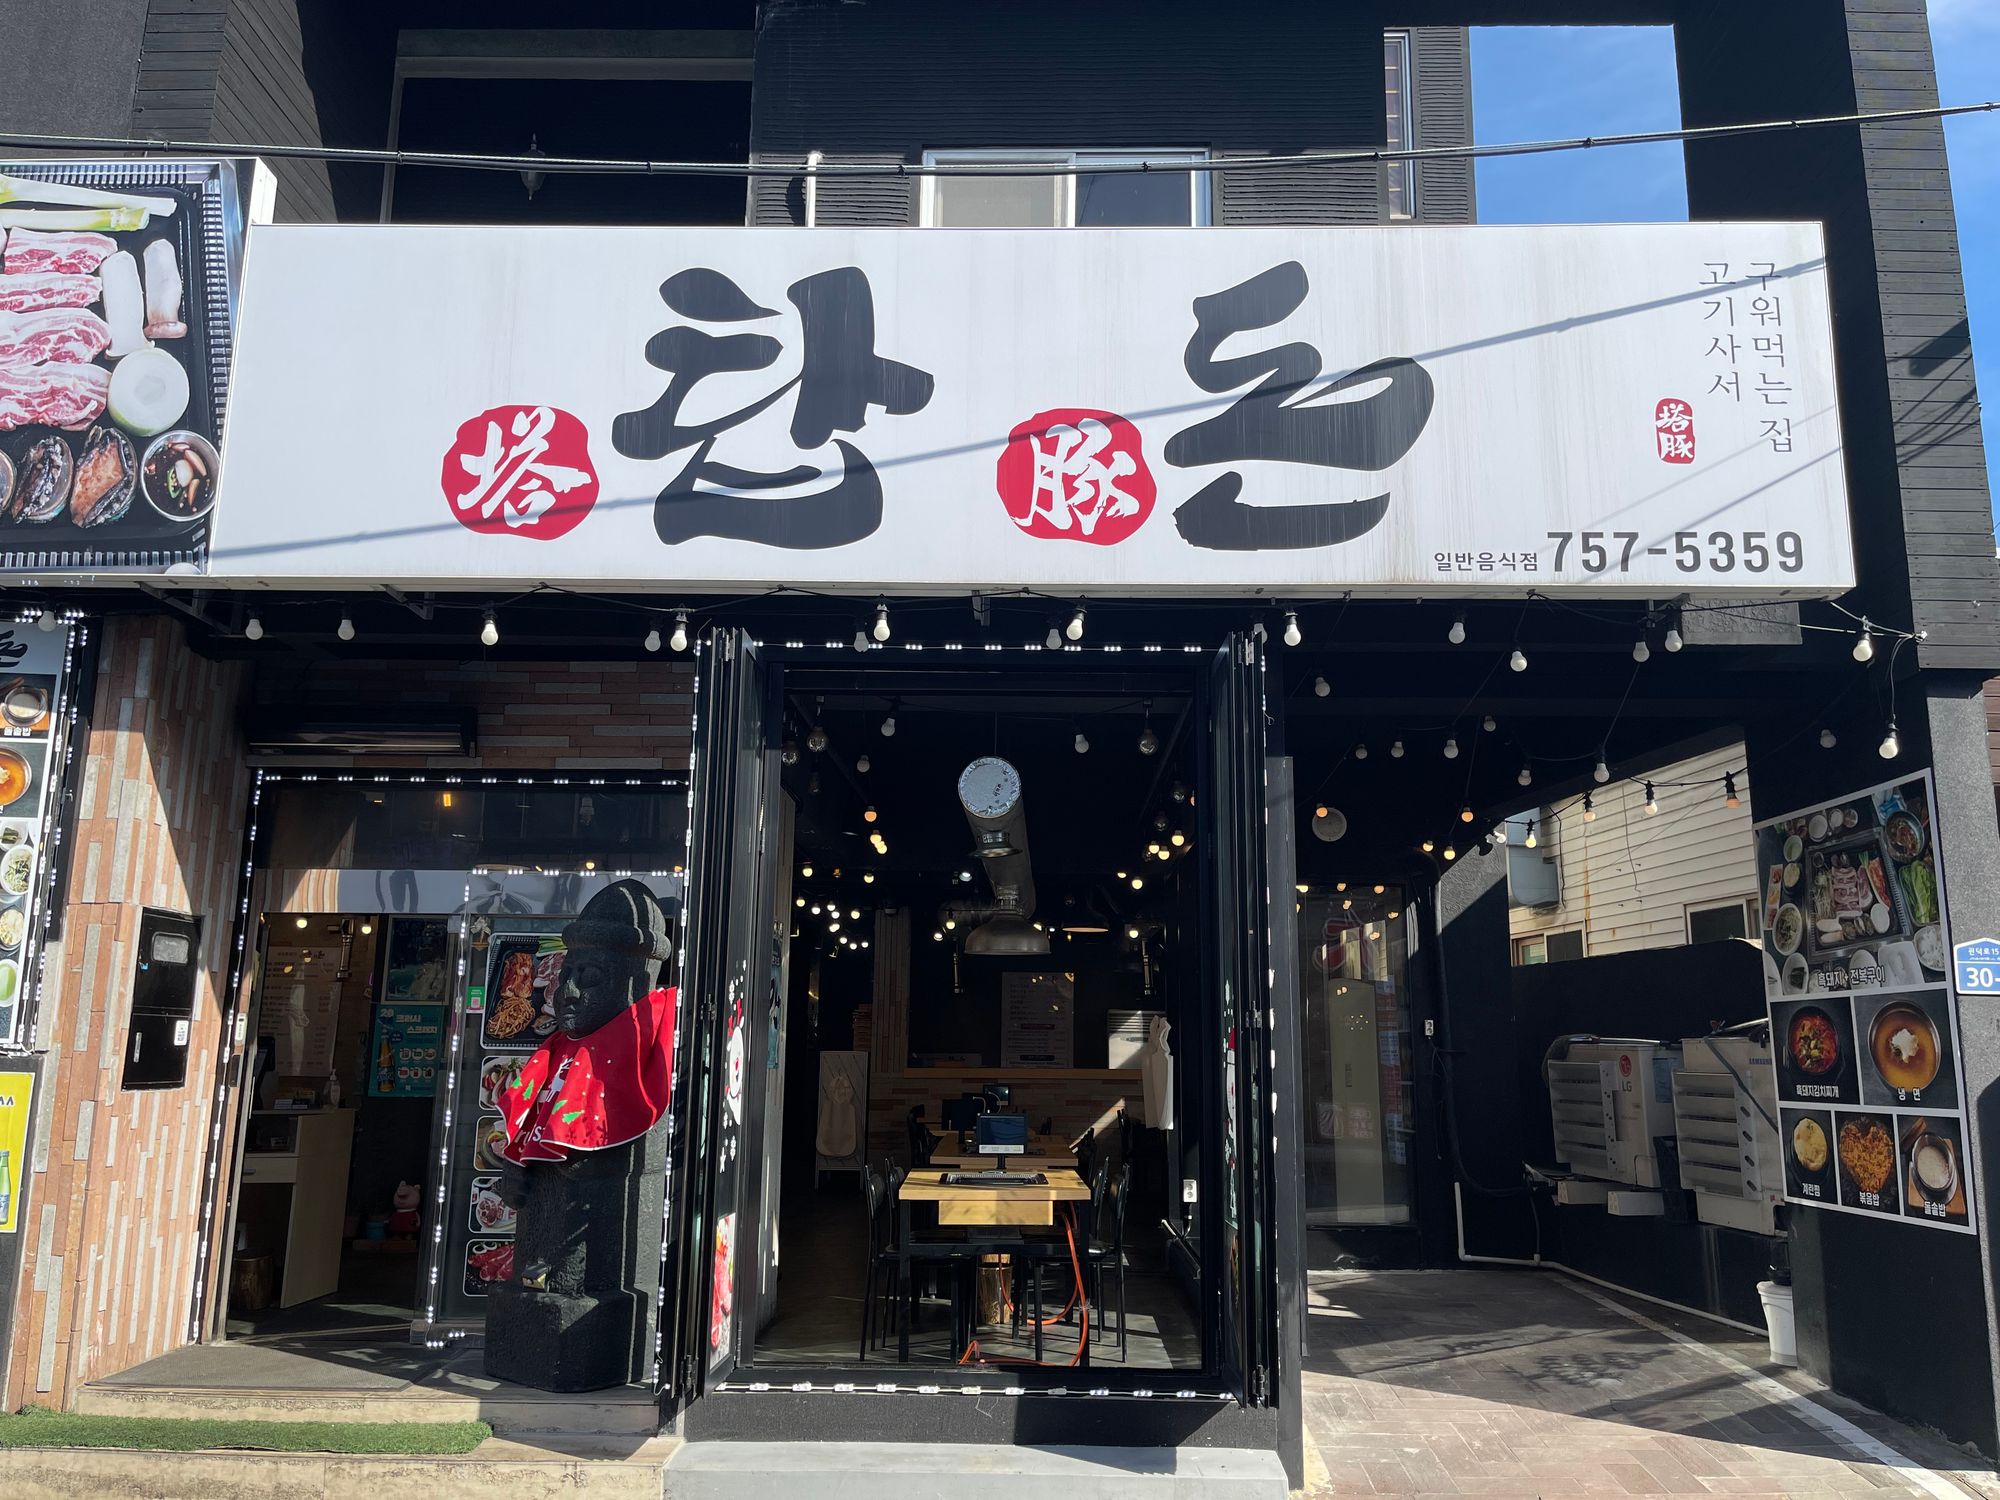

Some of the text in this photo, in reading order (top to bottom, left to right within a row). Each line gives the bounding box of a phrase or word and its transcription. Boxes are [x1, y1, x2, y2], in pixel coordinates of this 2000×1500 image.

[1434, 531, 1804, 573] 일반음식점 757-5359
[1817, 971, 1843, 987] 흑돼지
[1850, 966, 1885, 985] 전복구이
[1621, 1080, 1632, 1092] LG
[1796, 1084, 1839, 1098] 흑돼지김치찌개
[1801, 1183, 1821, 1197] 계란찜
[1859, 1191, 1880, 1207] 볶음밥
